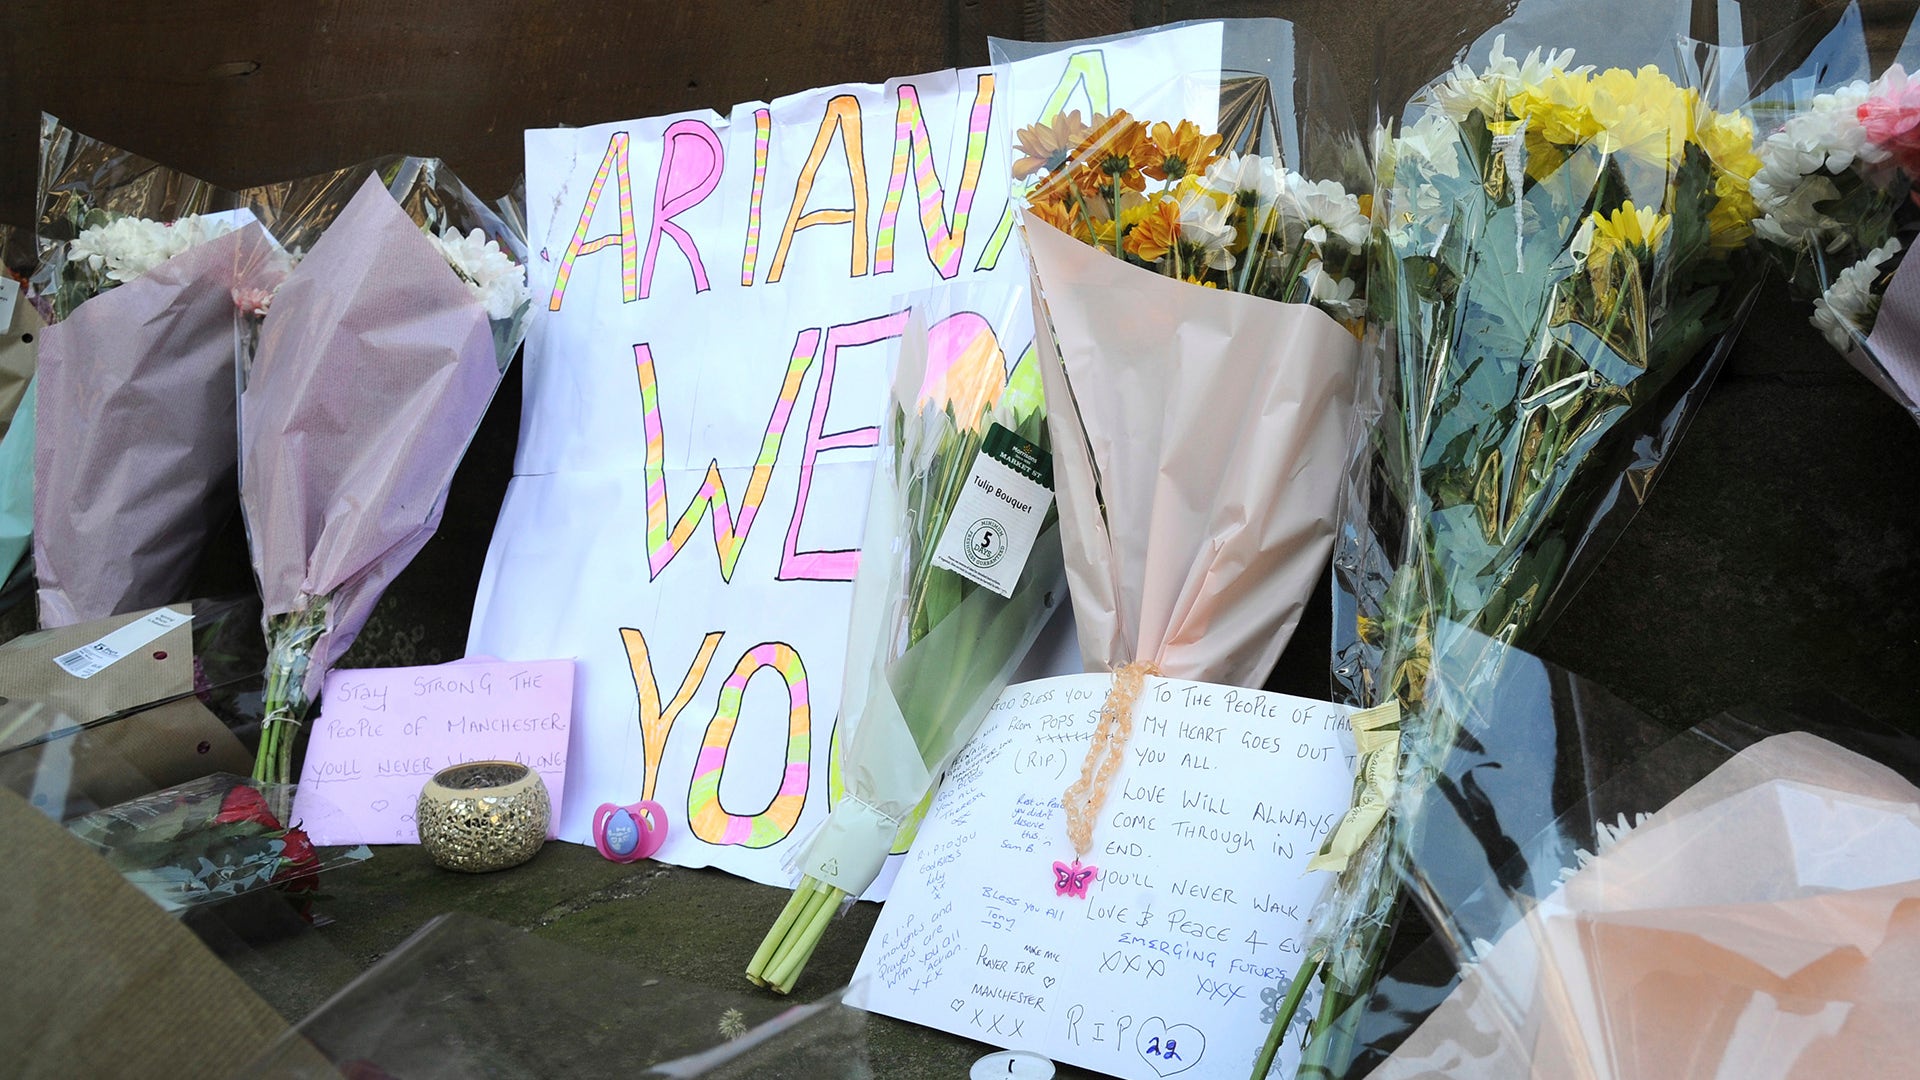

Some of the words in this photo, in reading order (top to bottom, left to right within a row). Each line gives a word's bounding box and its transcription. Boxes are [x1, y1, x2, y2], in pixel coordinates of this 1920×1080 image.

[633, 306, 912, 584] WE
[1000, 452, 1032, 472] MARKET
[1032, 470, 1042, 478] ST
[974, 475, 994, 495] Tulip
[995, 488, 1032, 514] Bouquet
[981, 521, 1004, 536] MINIMUM
[981, 531, 993, 548] 5
[974, 543, 992, 557] DAYS
[413, 673, 492, 696] STRONG
[509, 670, 542, 690] THE
[1066, 689, 1093, 703] YOU
[1154, 682, 1176, 703] TO
[1182, 686, 1212, 708] THE
[1224, 689, 1278, 718] PEOPLE
[1292, 705, 1317, 725] OF
[327, 718, 385, 740] PEOPLE
[403, 716, 427, 737] OF
[1143, 715, 1167, 738] MY
[1179, 720, 1228, 745] HEART
[1241, 731, 1281, 753] GOES
[1297, 744, 1335, 762] OUT
[378, 757, 433, 772] NEVER
[1135, 747, 1167, 767] YOU
[1112, 812, 1156, 831] COME
[1123, 779, 1166, 804] LOVE
[1252, 802, 1335, 842] ALWAYS
[932, 901, 952, 922] and
[1172, 880, 1237, 904] NEVER
[1253, 894, 1299, 921] WALK
[923, 924, 943, 946] are
[1087, 896, 1128, 922] LOVE
[1245, 930, 1268, 954] 4
[1014, 961, 1035, 975] FOR
[971, 983, 1047, 1012] MANCHESTER
[1146, 1036, 1182, 1061] 22
